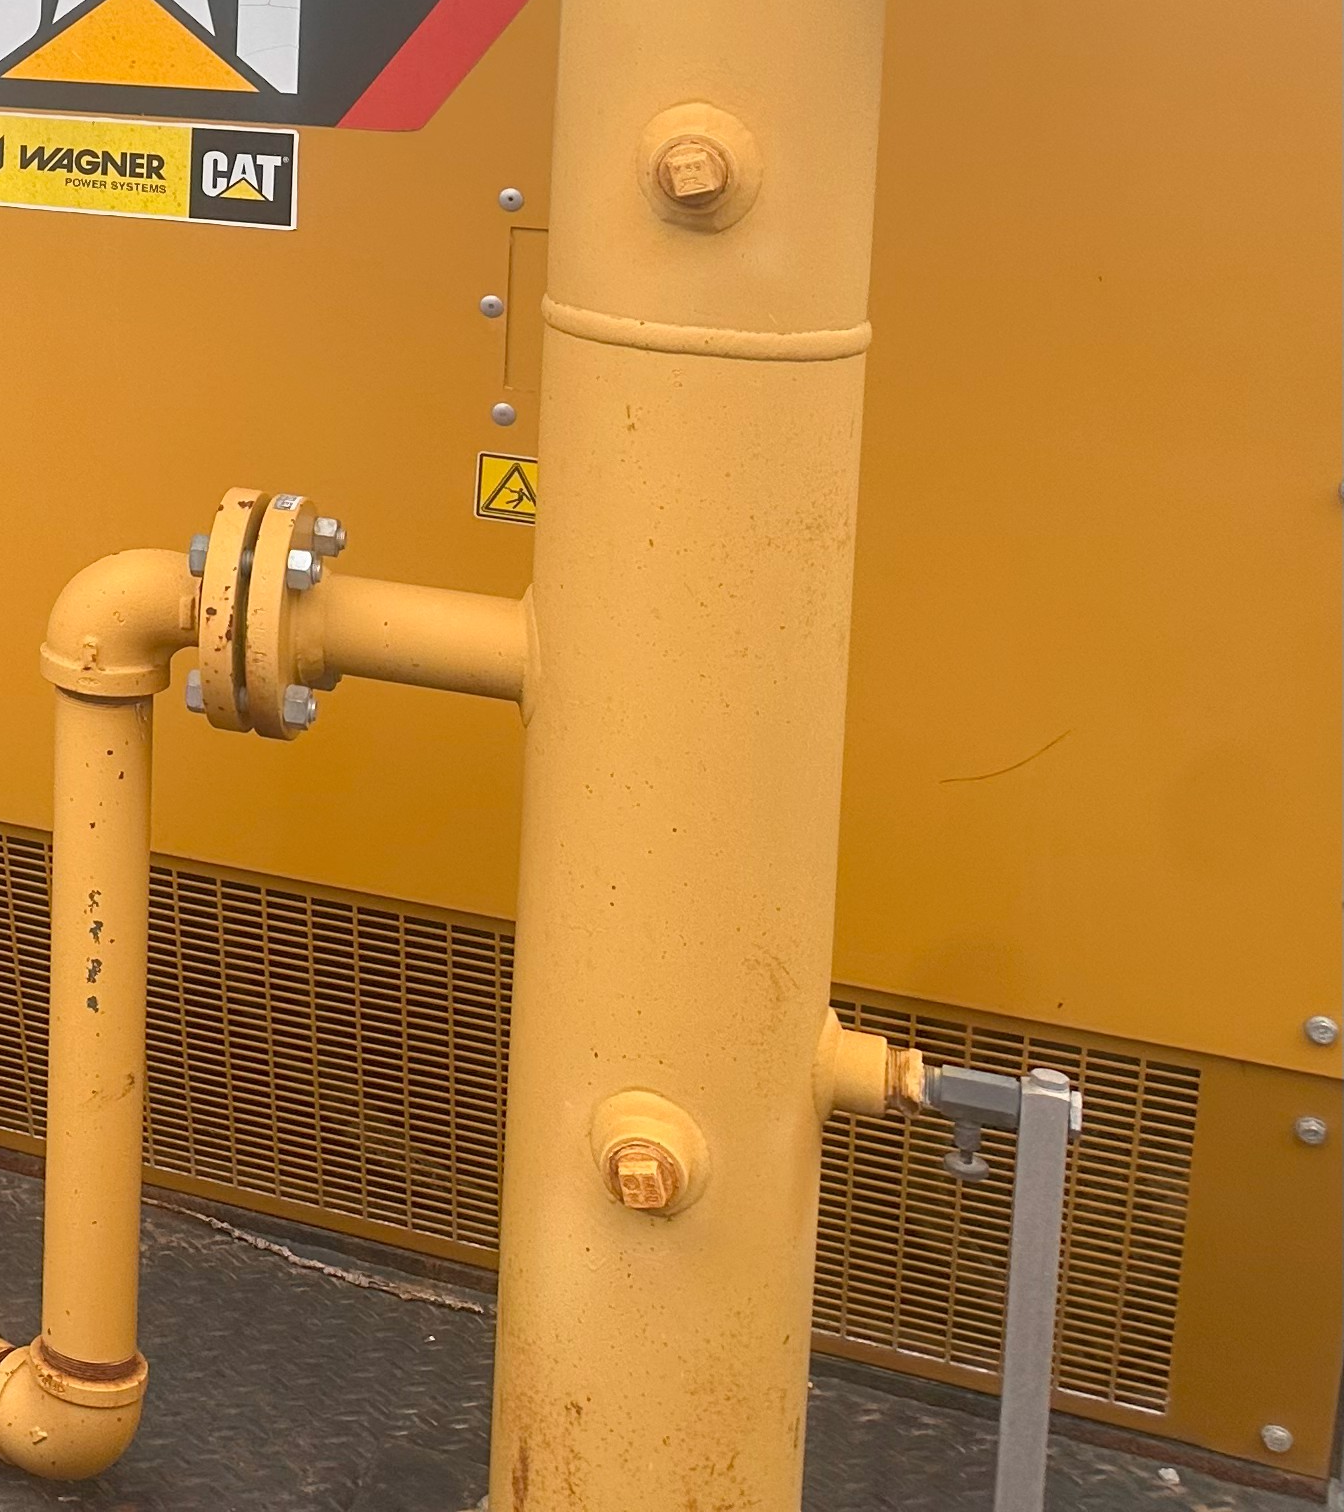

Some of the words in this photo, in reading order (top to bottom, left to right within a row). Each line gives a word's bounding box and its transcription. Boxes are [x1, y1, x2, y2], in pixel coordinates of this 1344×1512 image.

[20, 144, 166, 181] WAGNER
[202, 150, 282, 202] CAT
[64, 177, 108, 192] POWER
[110, 180, 167, 196] SYSTEMS
